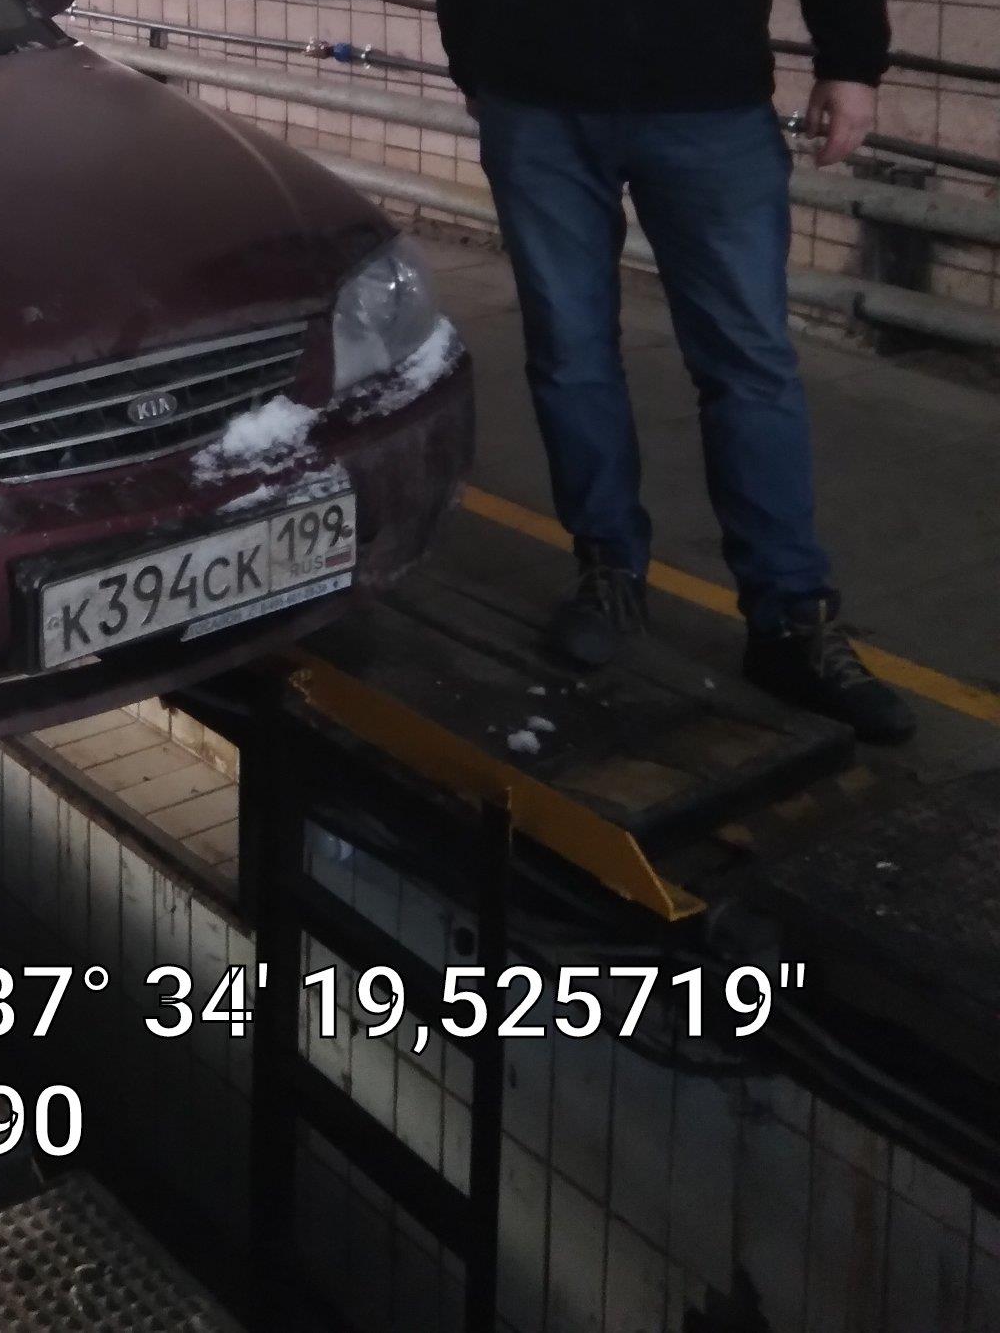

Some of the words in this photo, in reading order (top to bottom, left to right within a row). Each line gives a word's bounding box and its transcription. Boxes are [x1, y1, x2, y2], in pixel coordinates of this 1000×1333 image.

[136, 397, 171, 420] KIA
[276, 503, 345, 563] 199
[288, 556, 325, 579] RUS
